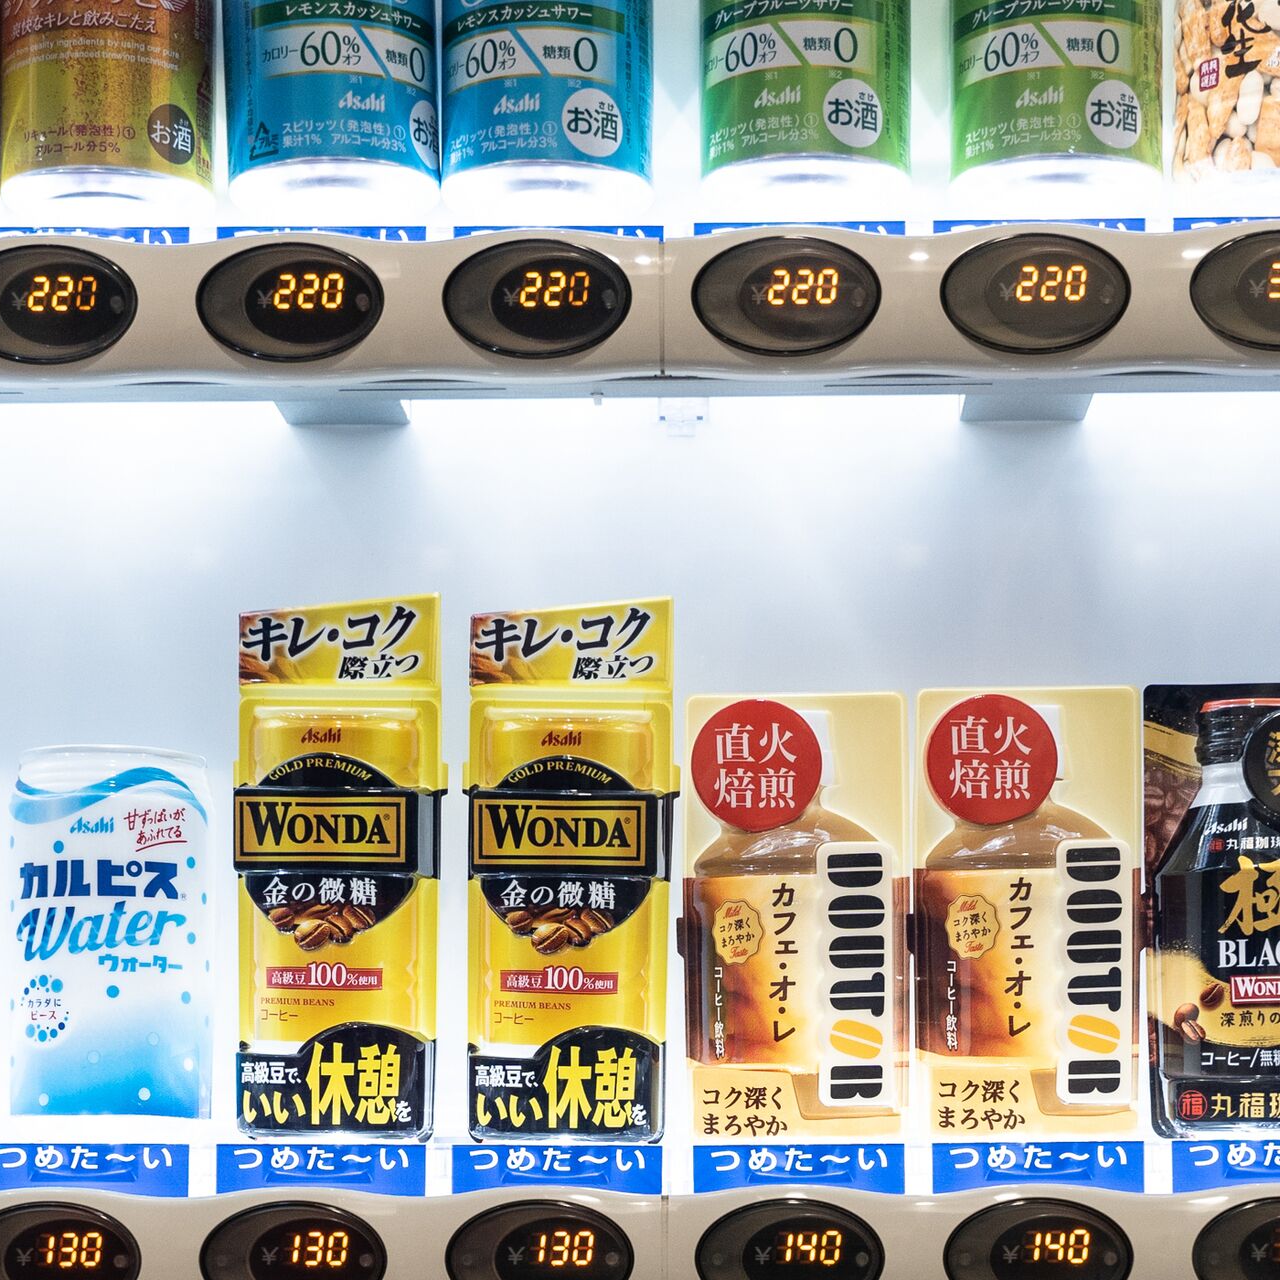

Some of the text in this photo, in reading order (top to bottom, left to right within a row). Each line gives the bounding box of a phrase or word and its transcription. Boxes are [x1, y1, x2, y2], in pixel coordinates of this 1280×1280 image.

[286, 2, 421, 29] レモンスカッシュサワー
[457, 4, 592, 32] レモンスカッシュサワー
[339, 90, 385, 113] Asahi
[493, 93, 541, 115] Asahi
[754, 85, 801, 108] Asahi
[1016, 85, 1064, 108] Asahi
[567, 106, 618, 143] お酒
[827, 98, 878, 133] お酒
[1090, 99, 1138, 134] お酒
[151, 120, 192, 153] お酒
[242, 606, 416, 661] キレ・コク
[475, 607, 651, 662] キレ・コク
[338, 654, 419, 679] 際立つ
[572, 655, 653, 679] 際立つ
[301, 728, 342, 744] Asahi
[541, 730, 582, 746] Asahi
[269, 758, 372, 781] GOLD PREMIUM
[508, 761, 613, 784] GOLD PREMIUM
[70, 816, 114, 834] Asahi
[137, 825, 182, 845] あふれてる
[247, 802, 390, 846] WONDA
[485, 804, 631, 849] WONDA
[20, 859, 178, 899] カルピス
[263, 876, 378, 905] 金の微糖
[500, 879, 616, 910] 金の微糖
[17, 900, 187, 961] Water
[719, 917, 751, 932] コク深く
[953, 912, 987, 927] コク深く
[721, 933, 755, 948] まろやか
[955, 926, 991, 943] まろやか
[827, 853, 885, 1099] DOUTOR
[1067, 847, 1123, 1094] DOUTOR
[28, 999, 61, 1008] カラダに
[261, 997, 301, 1006] PREMIUM
[494, 1000, 571, 1010] PREMIUM BEANS
[946, 961, 958, 1051] コーヒー飲料
[261, 1009, 299, 1021] コーヒー
[494, 1012, 534, 1024] コーヒー
[703, 1087, 783, 1110] コク深く
[939, 1080, 1020, 1103] コク深く
[703, 1114, 788, 1137] まろやか
[938, 1107, 1025, 1130] まろやか
